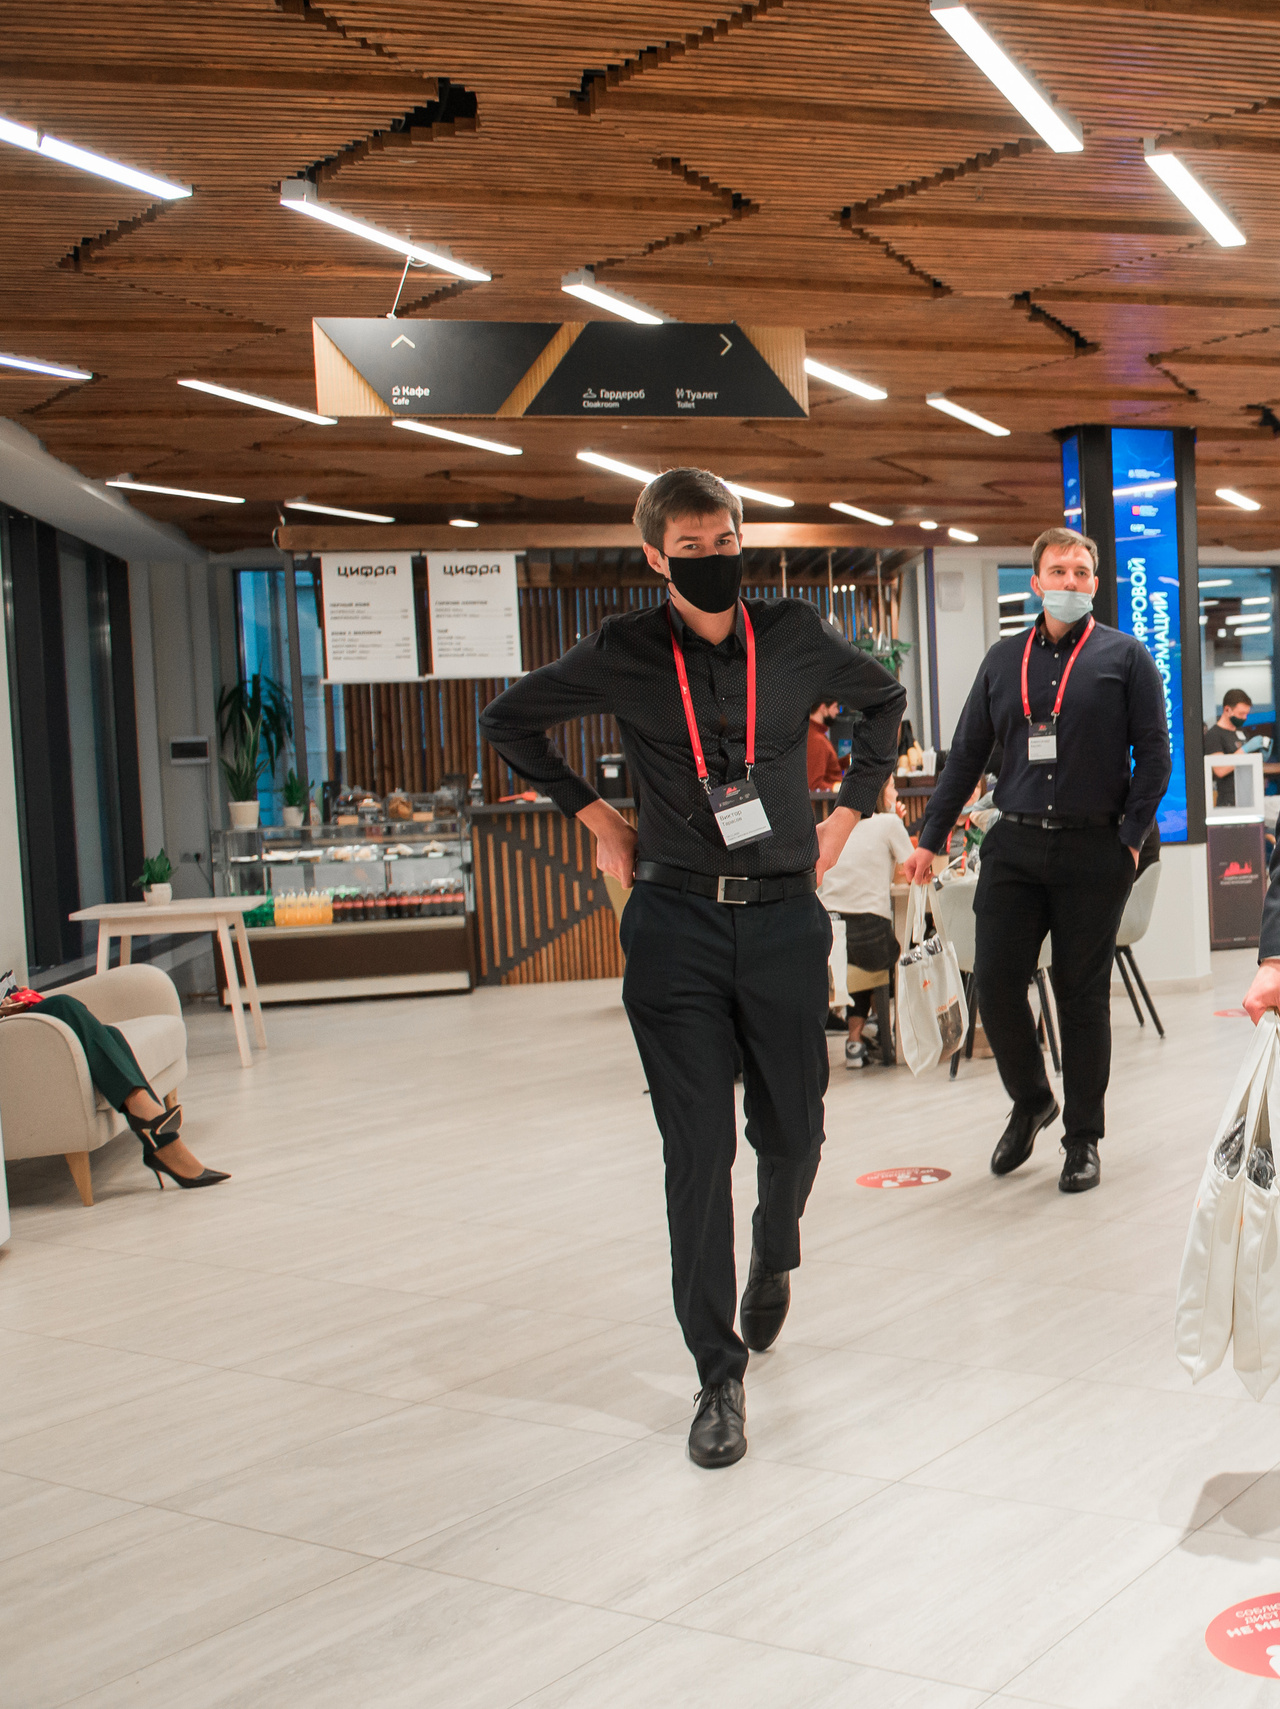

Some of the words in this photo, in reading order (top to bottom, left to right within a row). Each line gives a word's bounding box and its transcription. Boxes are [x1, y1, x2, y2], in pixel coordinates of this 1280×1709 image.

[401, 384, 430, 398] Кафе
[599, 388, 646, 402] Гардероб
[685, 388, 718, 400] Туалет
[392, 396, 410, 406] Cafe
[582, 400, 620, 408] Cloakroom
[677, 400, 695, 409] Toilet
[1226, 1625, 1254, 1639] НЕ
